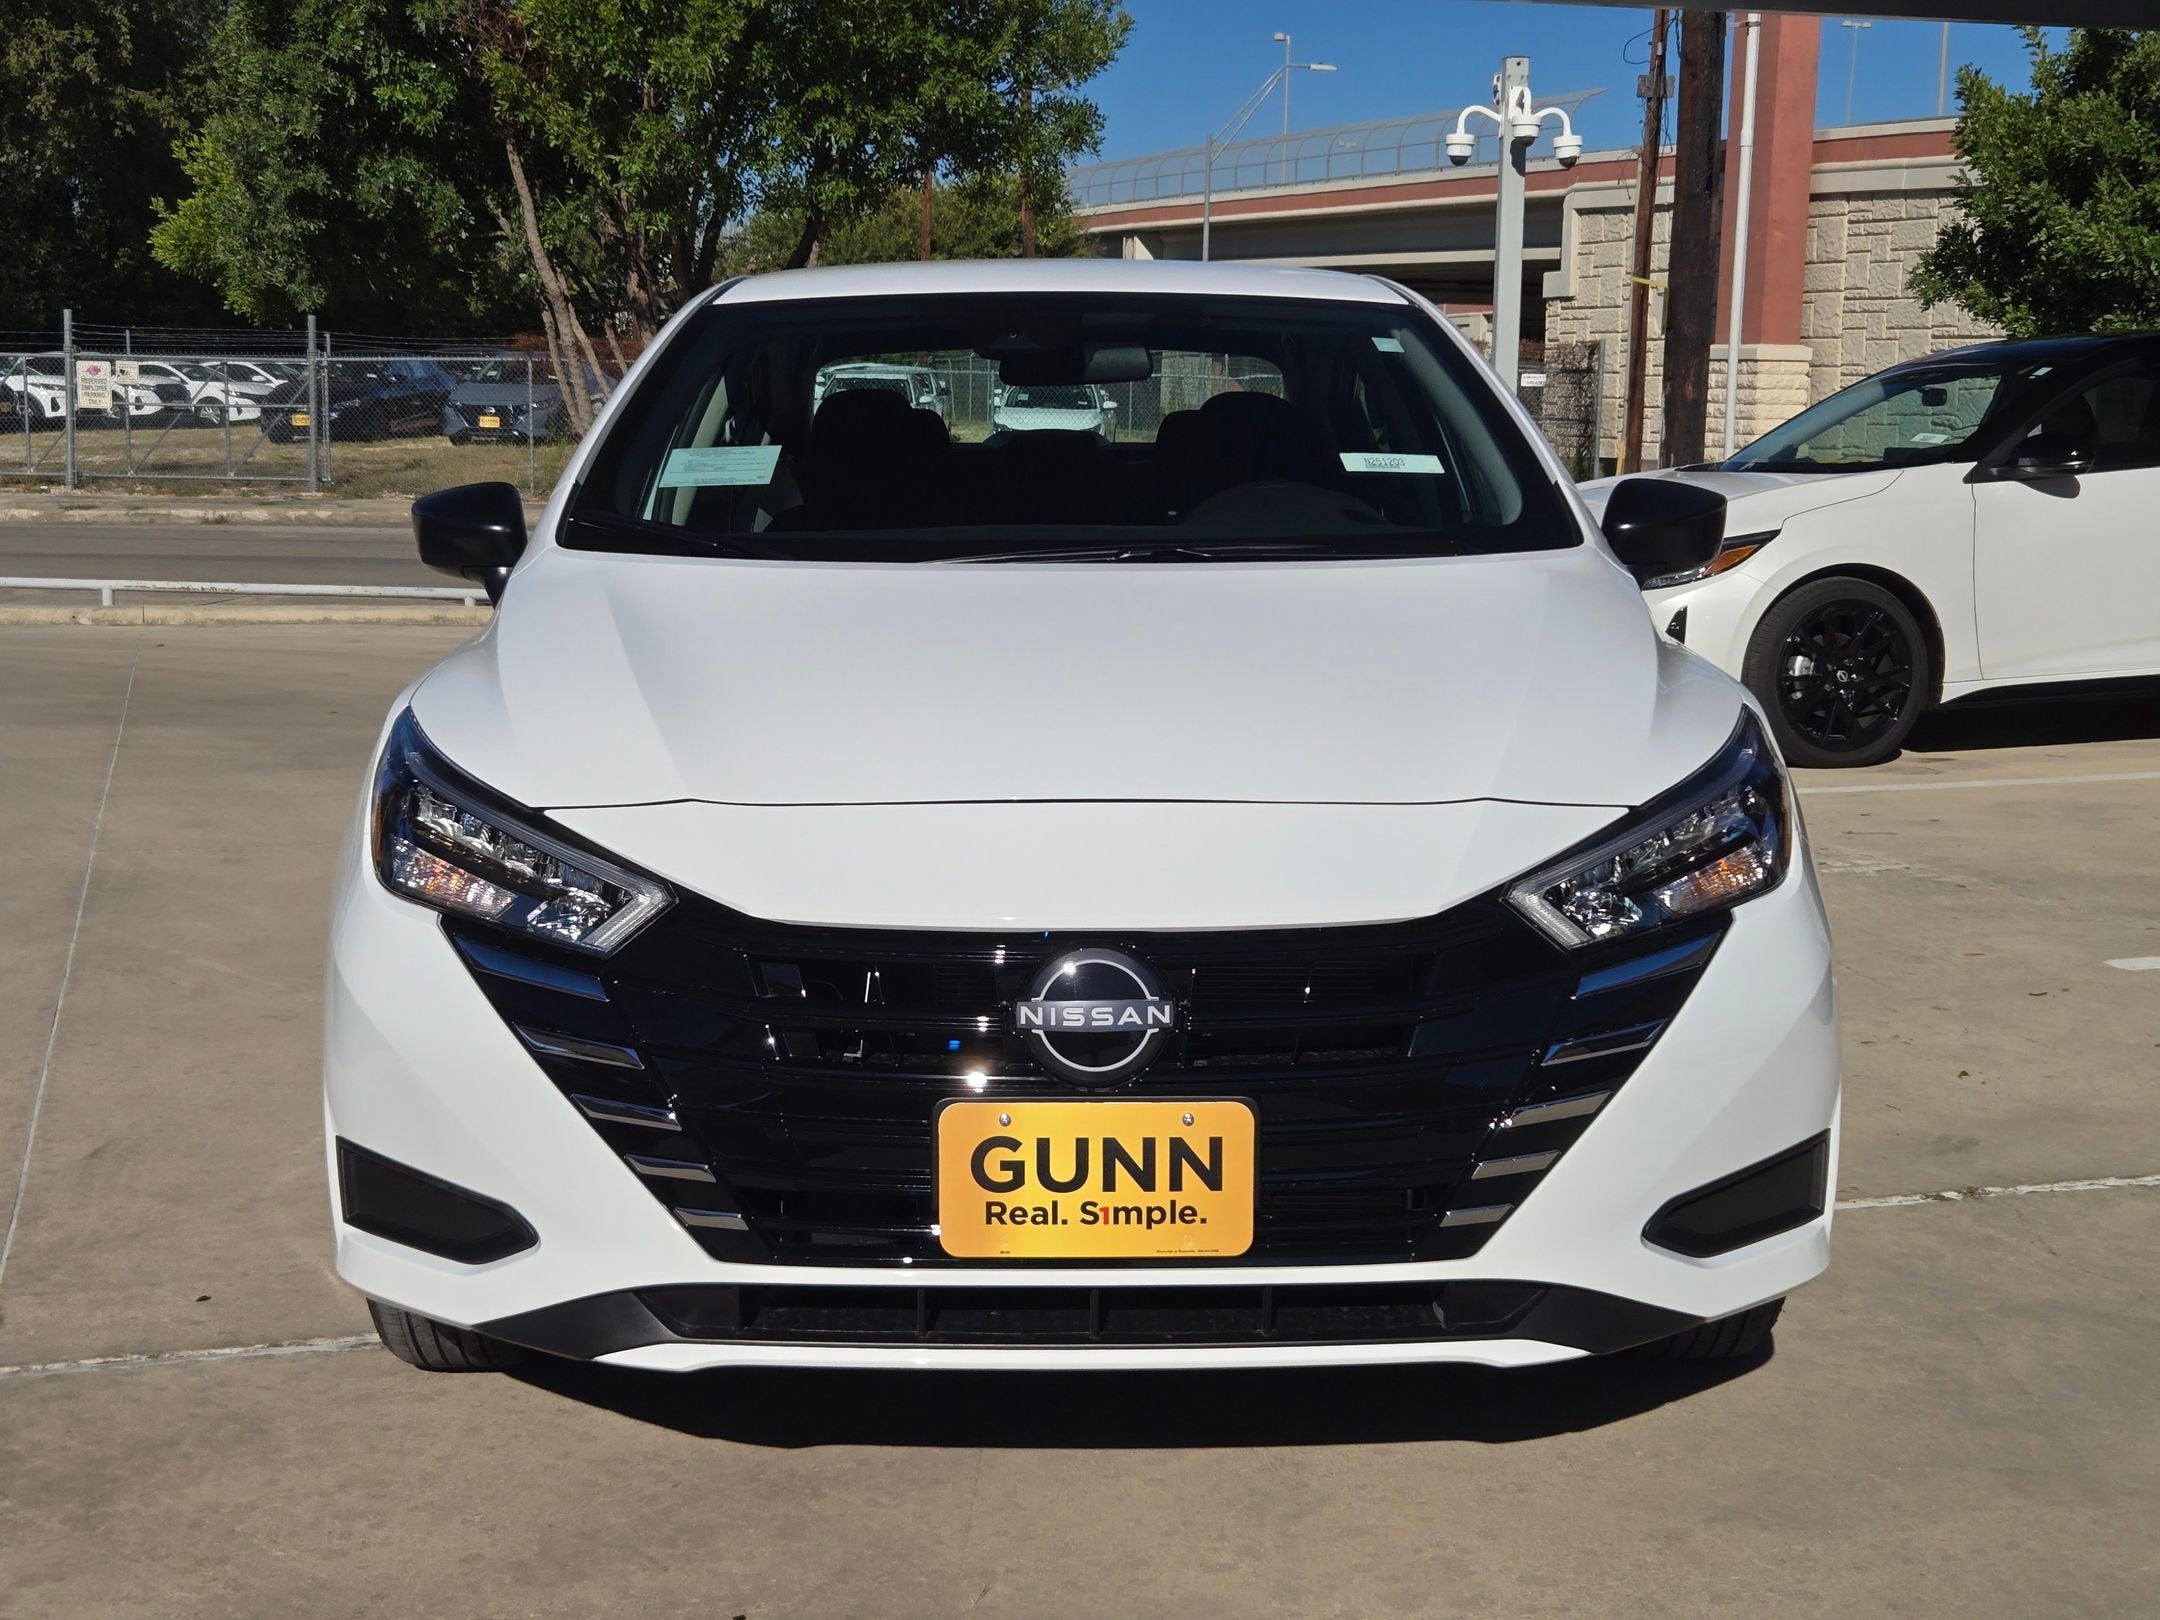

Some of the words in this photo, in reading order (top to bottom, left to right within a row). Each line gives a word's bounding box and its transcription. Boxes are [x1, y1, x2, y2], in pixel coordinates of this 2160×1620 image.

[1019, 1005, 1171, 1027] NISSAN
[970, 1135, 1223, 1194] GUNN
[985, 1199, 1068, 1226] Real.
